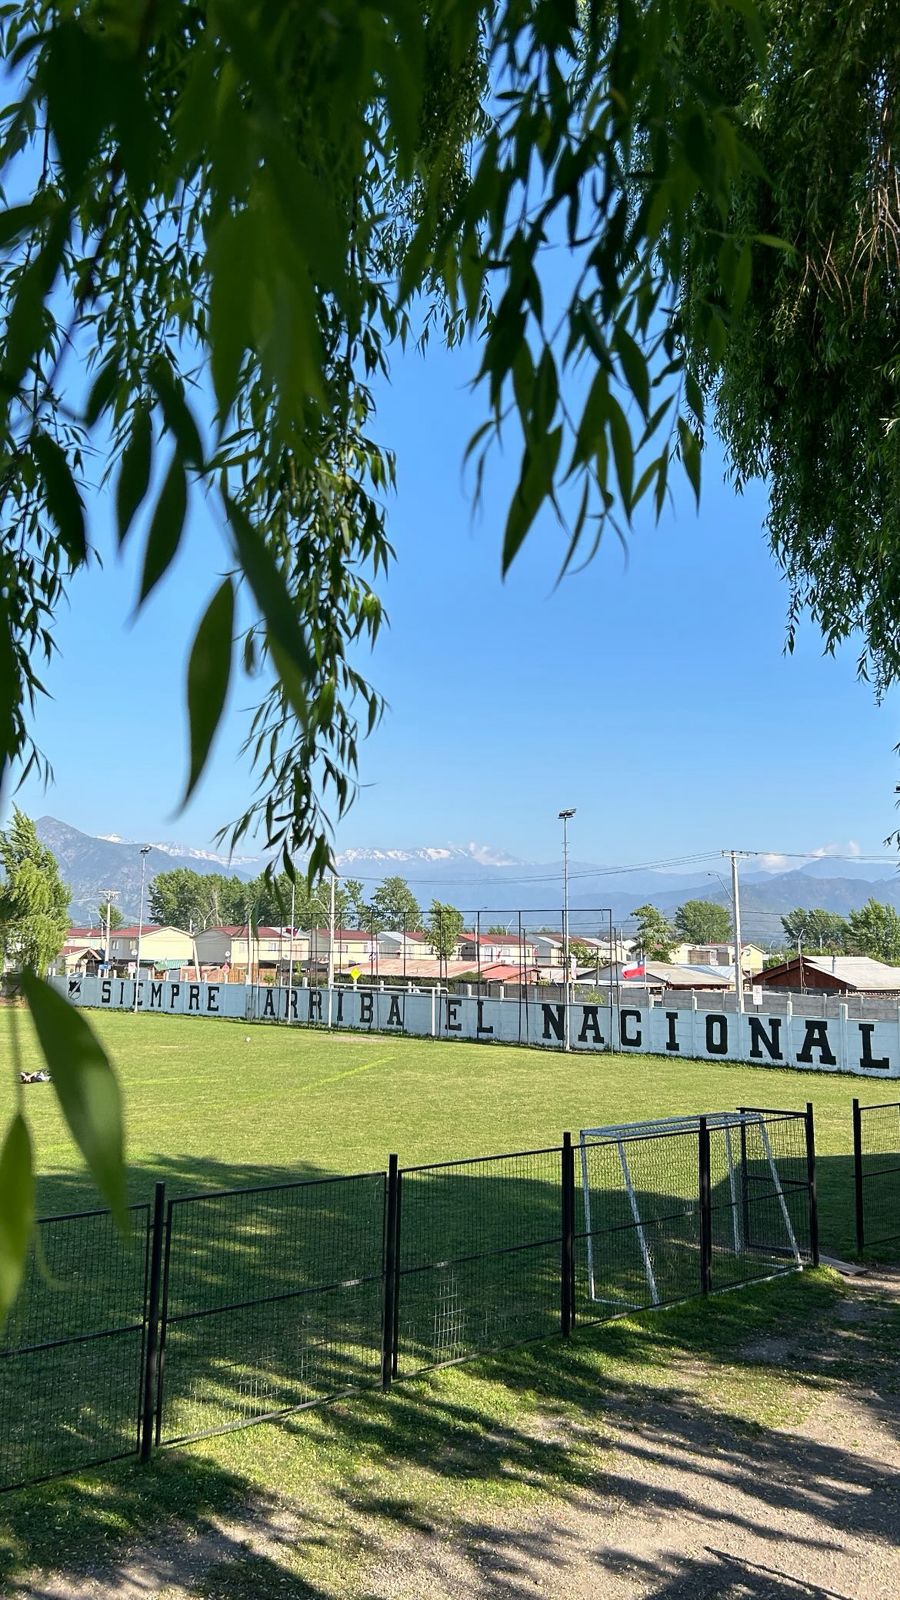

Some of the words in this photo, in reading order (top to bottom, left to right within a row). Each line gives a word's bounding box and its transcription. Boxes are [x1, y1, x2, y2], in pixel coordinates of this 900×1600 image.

[101, 980, 220, 1011] SIEMPRE
[263, 989, 403, 1026] ARRIBA
[444, 999, 494, 1034] EL
[541, 1003, 890, 1069] NACIONAL
